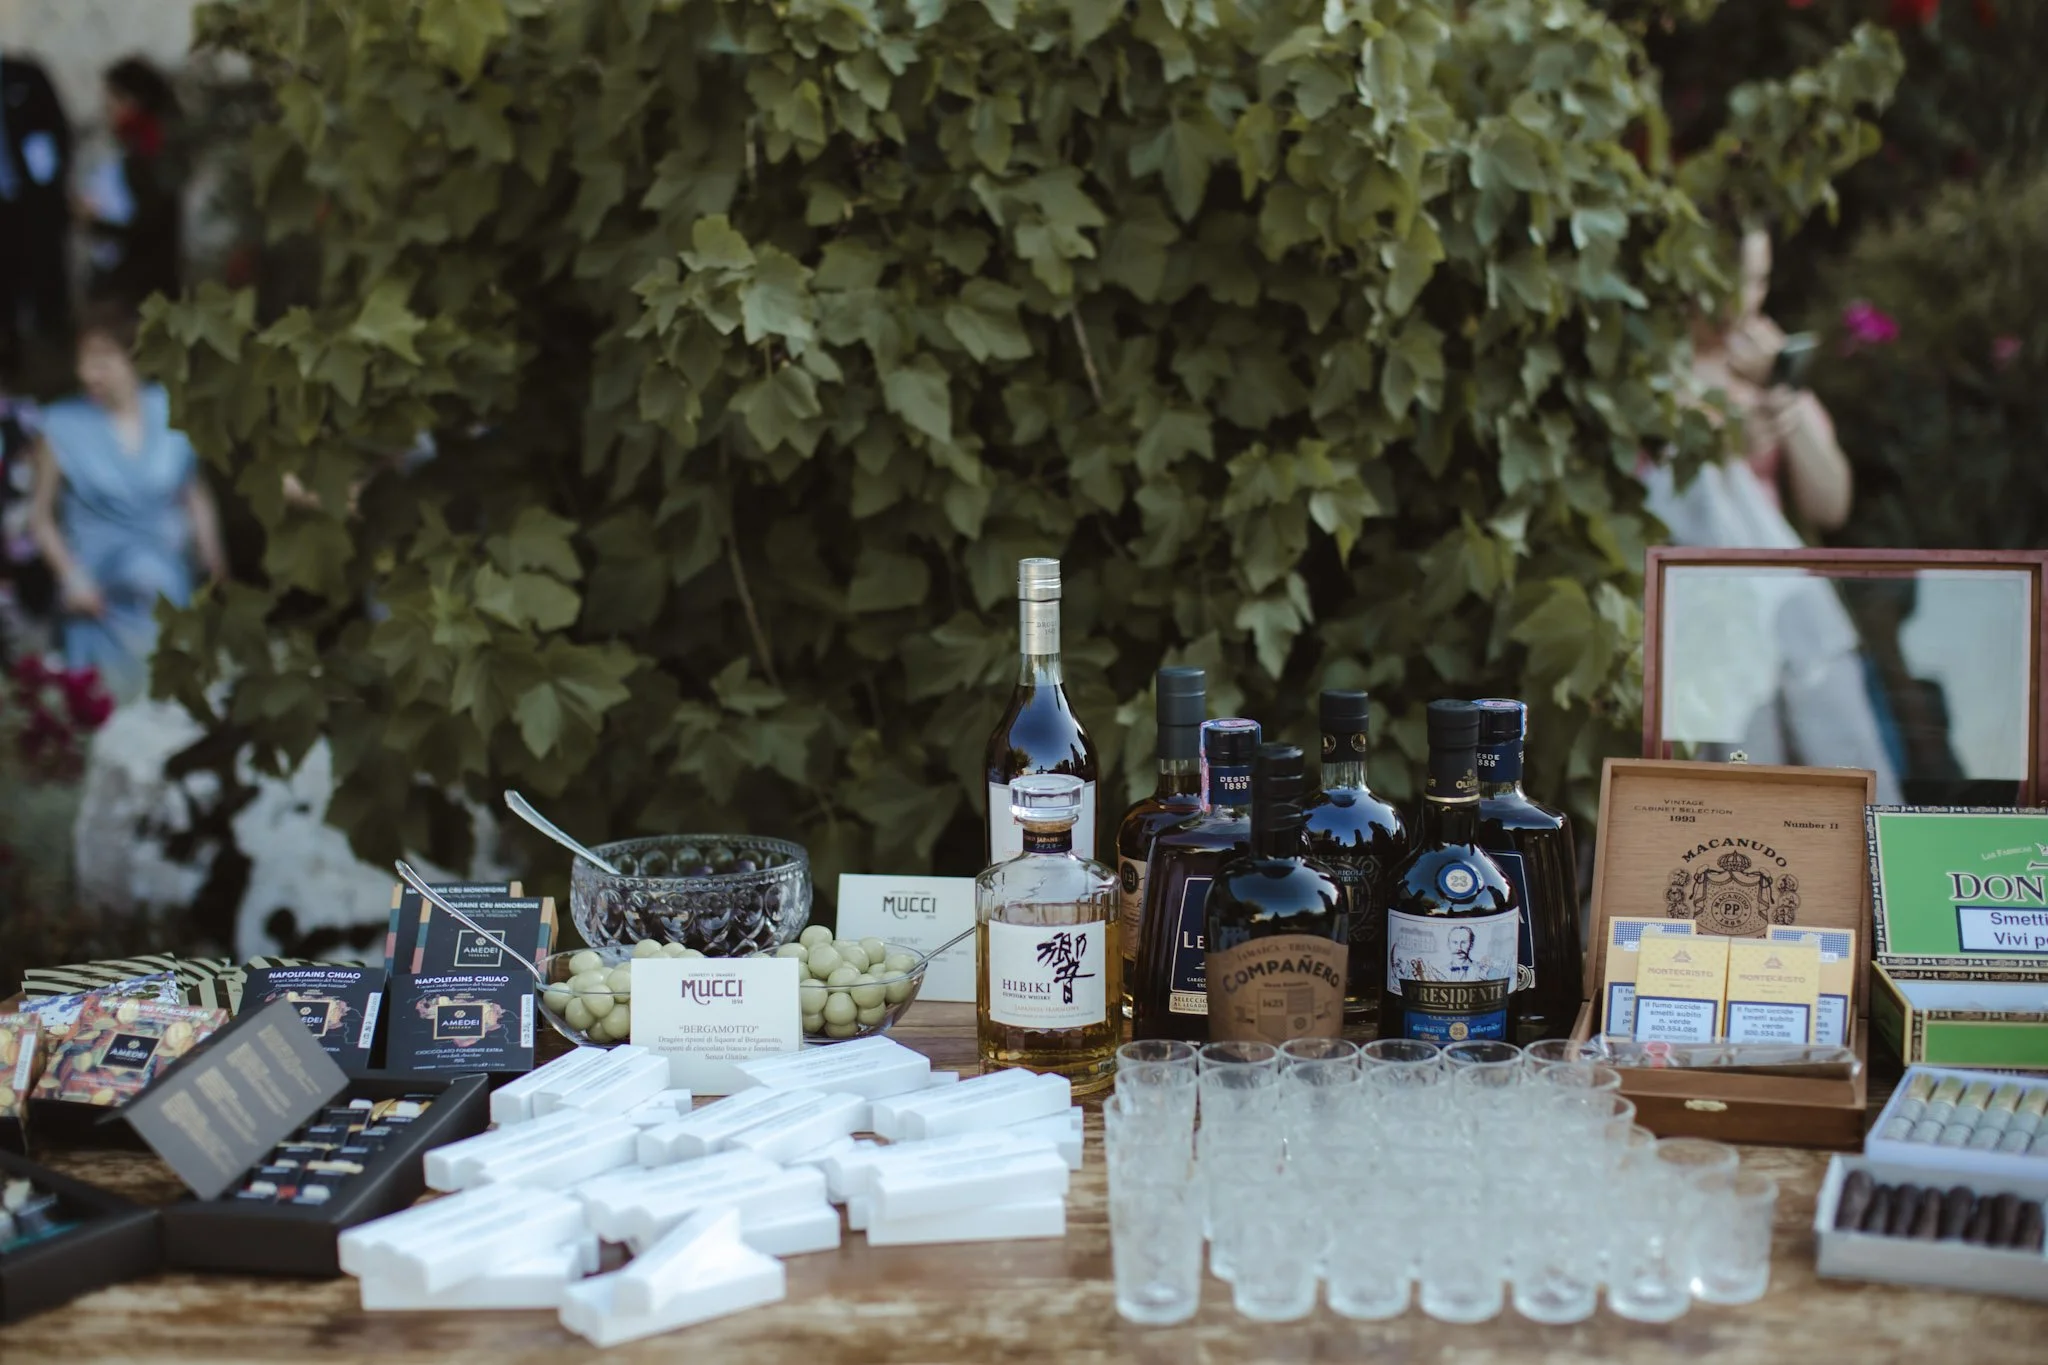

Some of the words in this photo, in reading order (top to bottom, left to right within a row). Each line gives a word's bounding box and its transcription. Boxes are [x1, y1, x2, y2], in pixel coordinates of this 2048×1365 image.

[1224, 782, 1247, 790] 1888
[1669, 815, 1696, 823] 1993
[1783, 820, 1826, 829] Number
[1681, 837, 1787, 868] MACANUDO
[1450, 875, 1468, 887] 23
[1946, 871, 2047, 905] DON
[882, 896, 936, 919] MUCCI
[1994, 932, 2028, 946] Vivi
[268, 971, 325, 980] NAPOLITAINS
[327, 971, 361, 980] CHUAO
[1223, 955, 1340, 993] COMPAÑERO
[1648, 967, 1713, 978] MONTECRISTO
[415, 976, 472, 985] NAPOLITAINS
[475, 975, 509, 983] CHUAO
[1739, 974, 1806, 984] MONTECRISTO
[1003, 979, 1051, 993] HIBIKI
[681, 979, 744, 1006] MUCCI
[1409, 985, 1504, 1003] PRESIDENTE
[1677, 1010, 1701, 1018] subito
[302, 1016, 324, 1024] EDEI
[679, 1025, 759, 1034] “BERGAMOTTO”
[658, 1036, 684, 1044] Dragées
[684, 1036, 705, 1044] ripieni
[714, 1036, 736, 1044] liquore
[744, 1036, 782, 1044] Bergamotto,
[109, 1048, 147, 1059] AMEDEI
[415, 1048, 455, 1056] CIOCCOLATO
